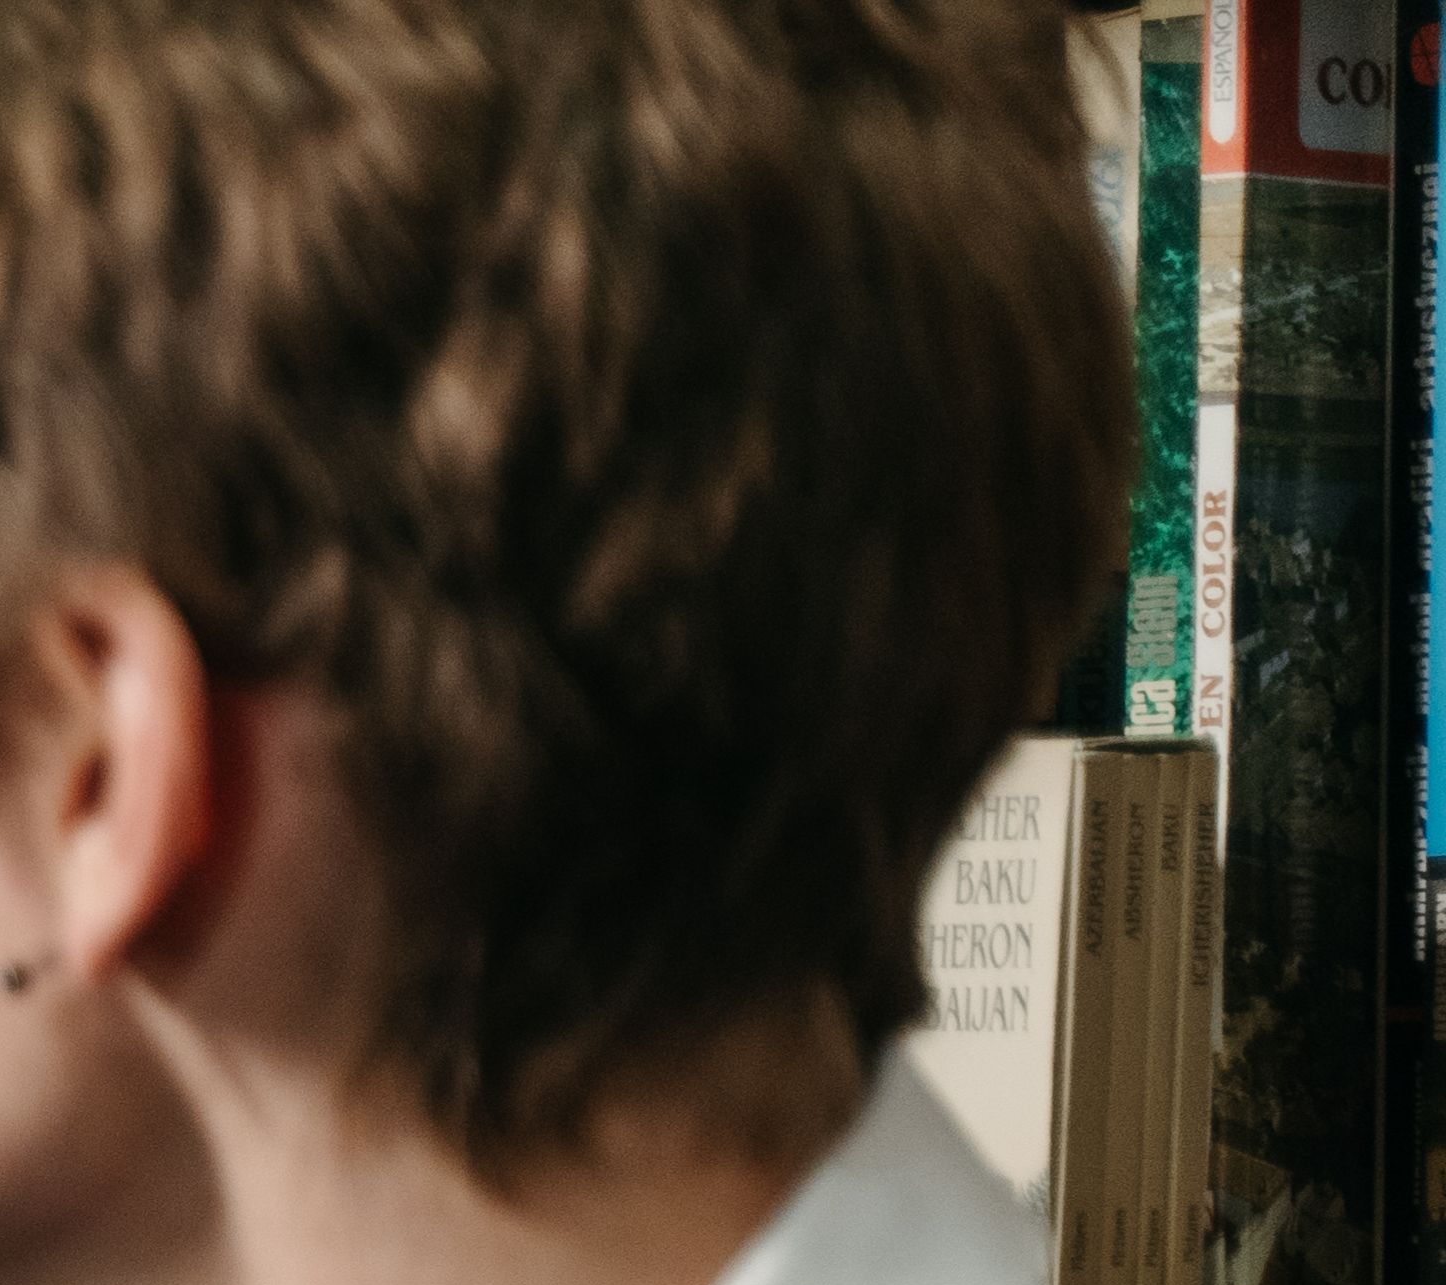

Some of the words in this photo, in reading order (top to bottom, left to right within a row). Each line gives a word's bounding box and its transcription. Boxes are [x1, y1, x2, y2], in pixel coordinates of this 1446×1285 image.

[1202, 490, 1227, 639] COLOR
[955, 859, 1038, 905] BAKU
[1086, 799, 1108, 957] AZERBAIJAN
[1124, 802, 1144, 939] ABSHERON
[1160, 802, 1179, 871] BAKU
[1192, 802, 1215, 987] ICHERISHEHER
